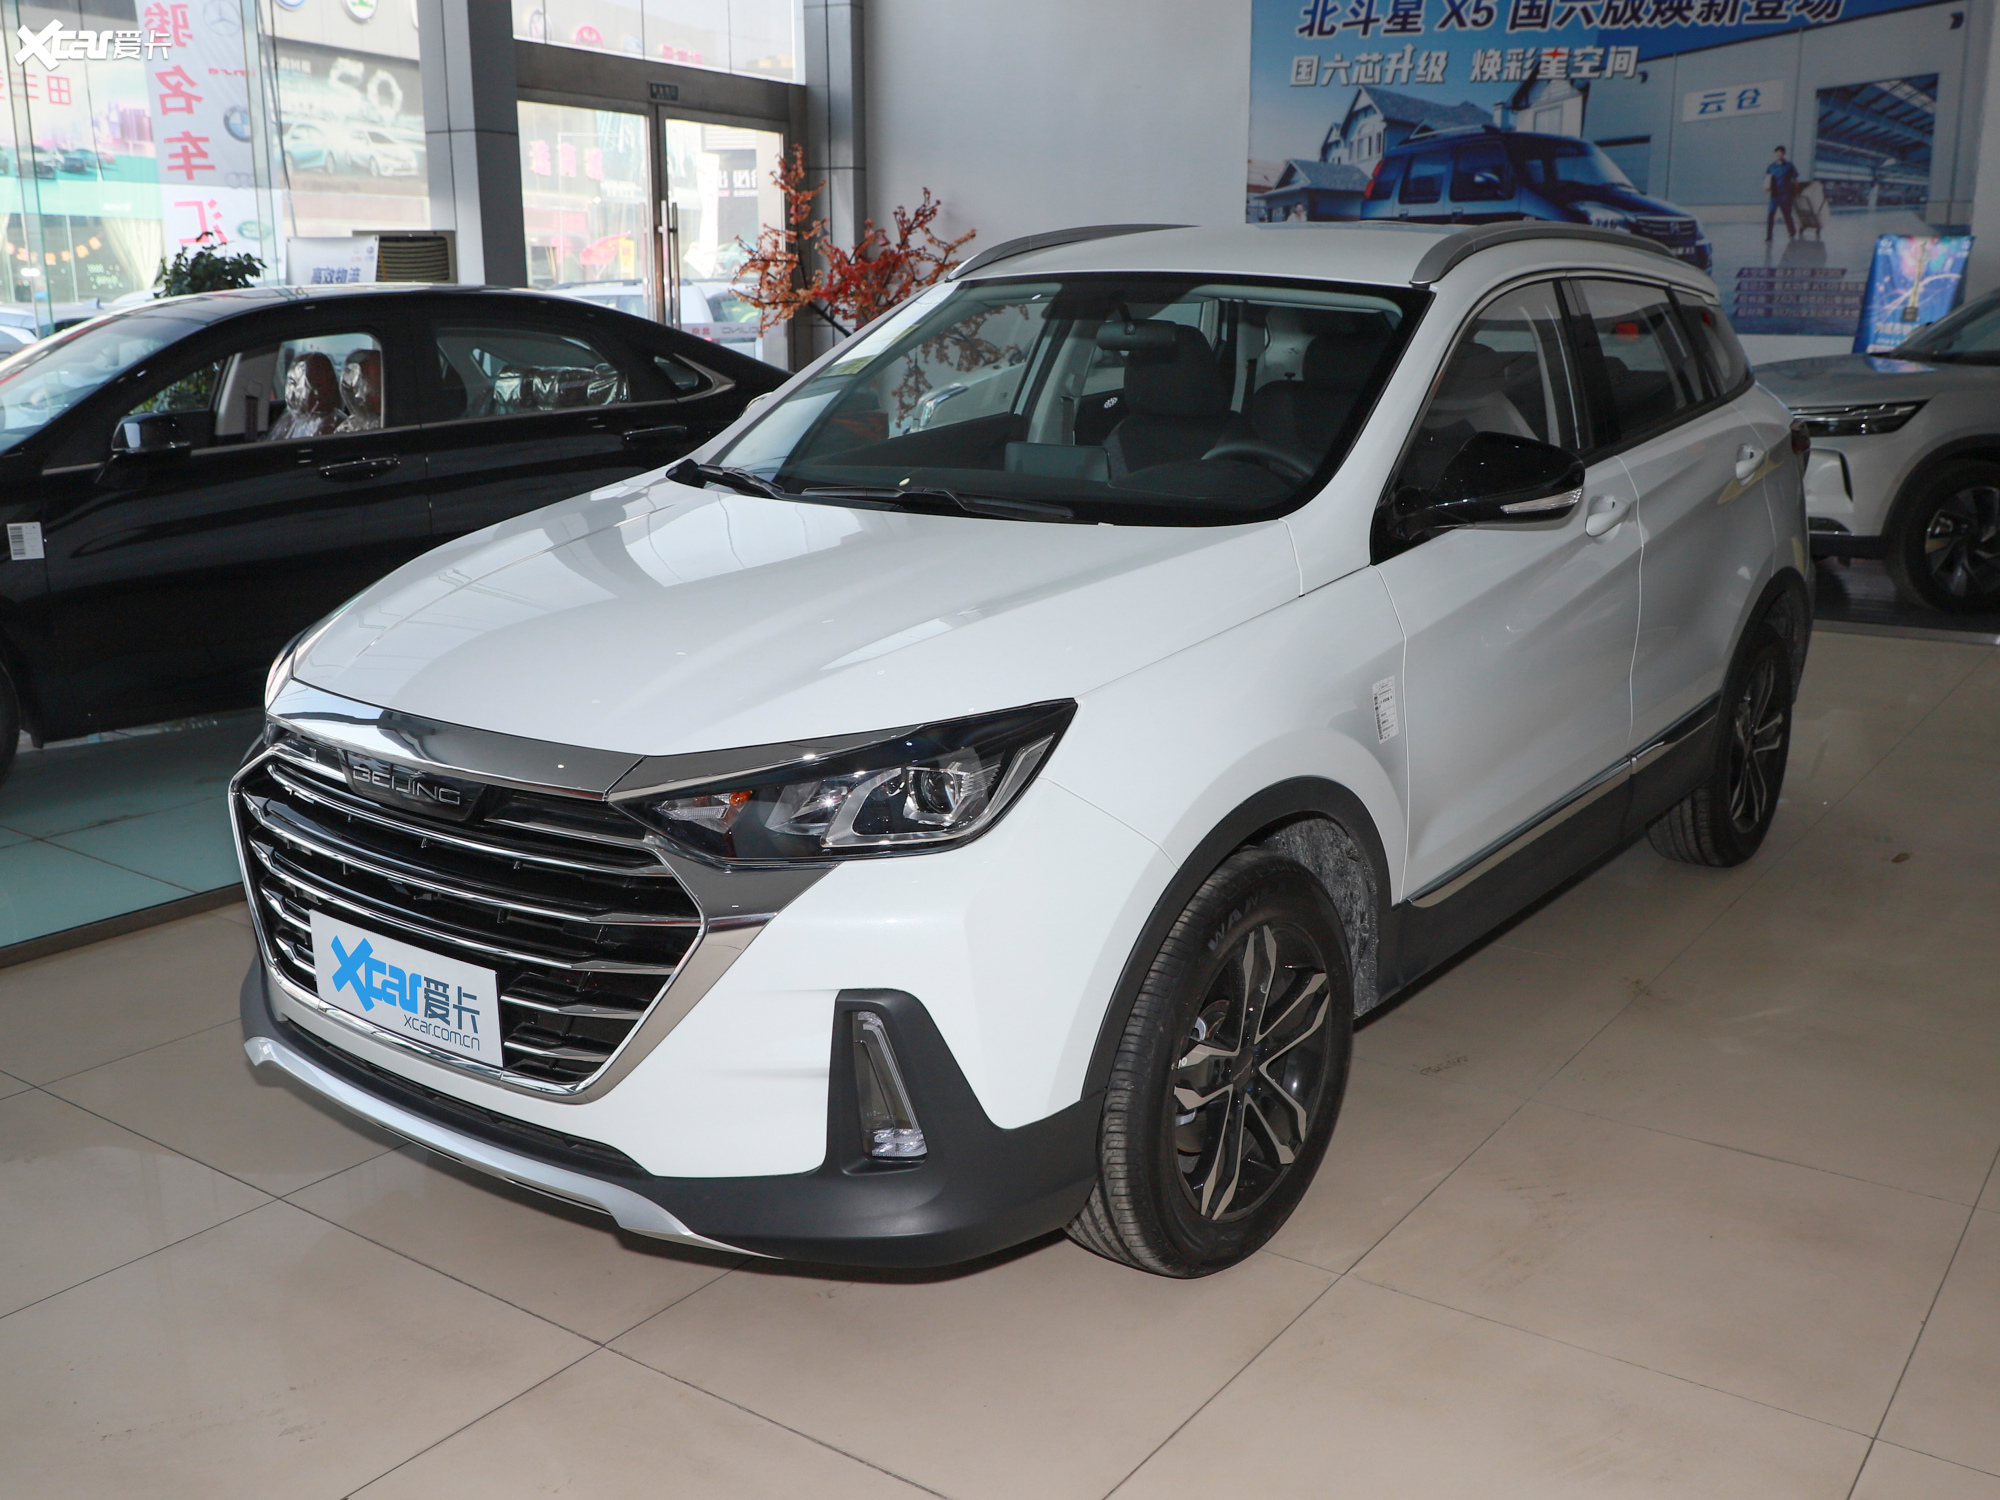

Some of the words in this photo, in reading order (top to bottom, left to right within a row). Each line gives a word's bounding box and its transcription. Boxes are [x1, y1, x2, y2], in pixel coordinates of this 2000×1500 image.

[1297, 0, 1424, 38] 北斗星
[1434, 0, 1497, 31] X5
[1290, 43, 1449, 87] 国六芯升级
[1469, 44, 1639, 83] 焕彩星空间
[1699, 88, 1762, 115] 云仓
[352, 765, 461, 805] BEIJING
[403, 1013, 481, 1052] xcar.com.cn
